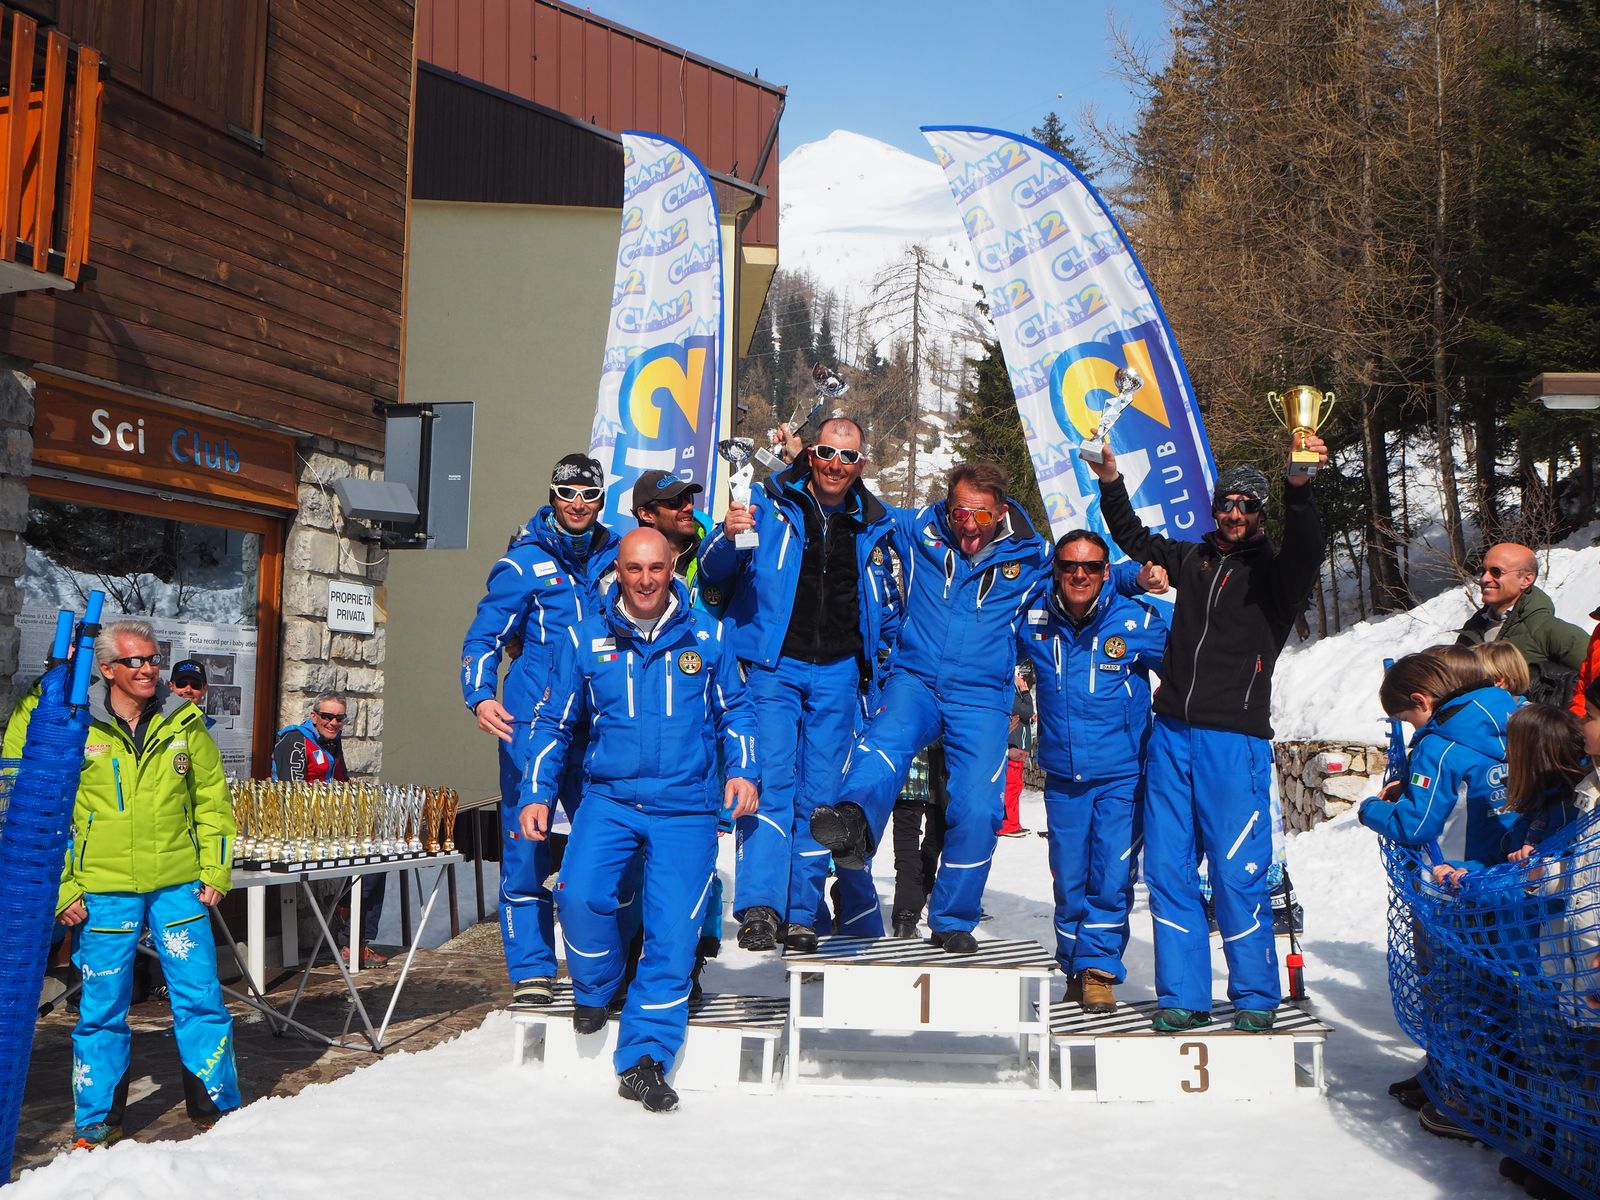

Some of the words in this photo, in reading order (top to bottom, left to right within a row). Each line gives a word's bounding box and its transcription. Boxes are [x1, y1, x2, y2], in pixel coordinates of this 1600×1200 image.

[616, 289, 692, 333] CLAN2
[1015, 283, 1111, 348] CLAN2
[91, 409, 145, 454] Sci
[171, 427, 240, 473] Club
[1156, 441, 1195, 529] CLUB
[336, 608, 366, 622] PRIVATA
[189, 636, 203, 644] Festa
[204, 637, 220, 645] record
[221, 640, 229, 648] per
[232, 639, 245, 649] baby
[913, 973, 931, 1024] 1
[1179, 1041, 1210, 1093] 3
